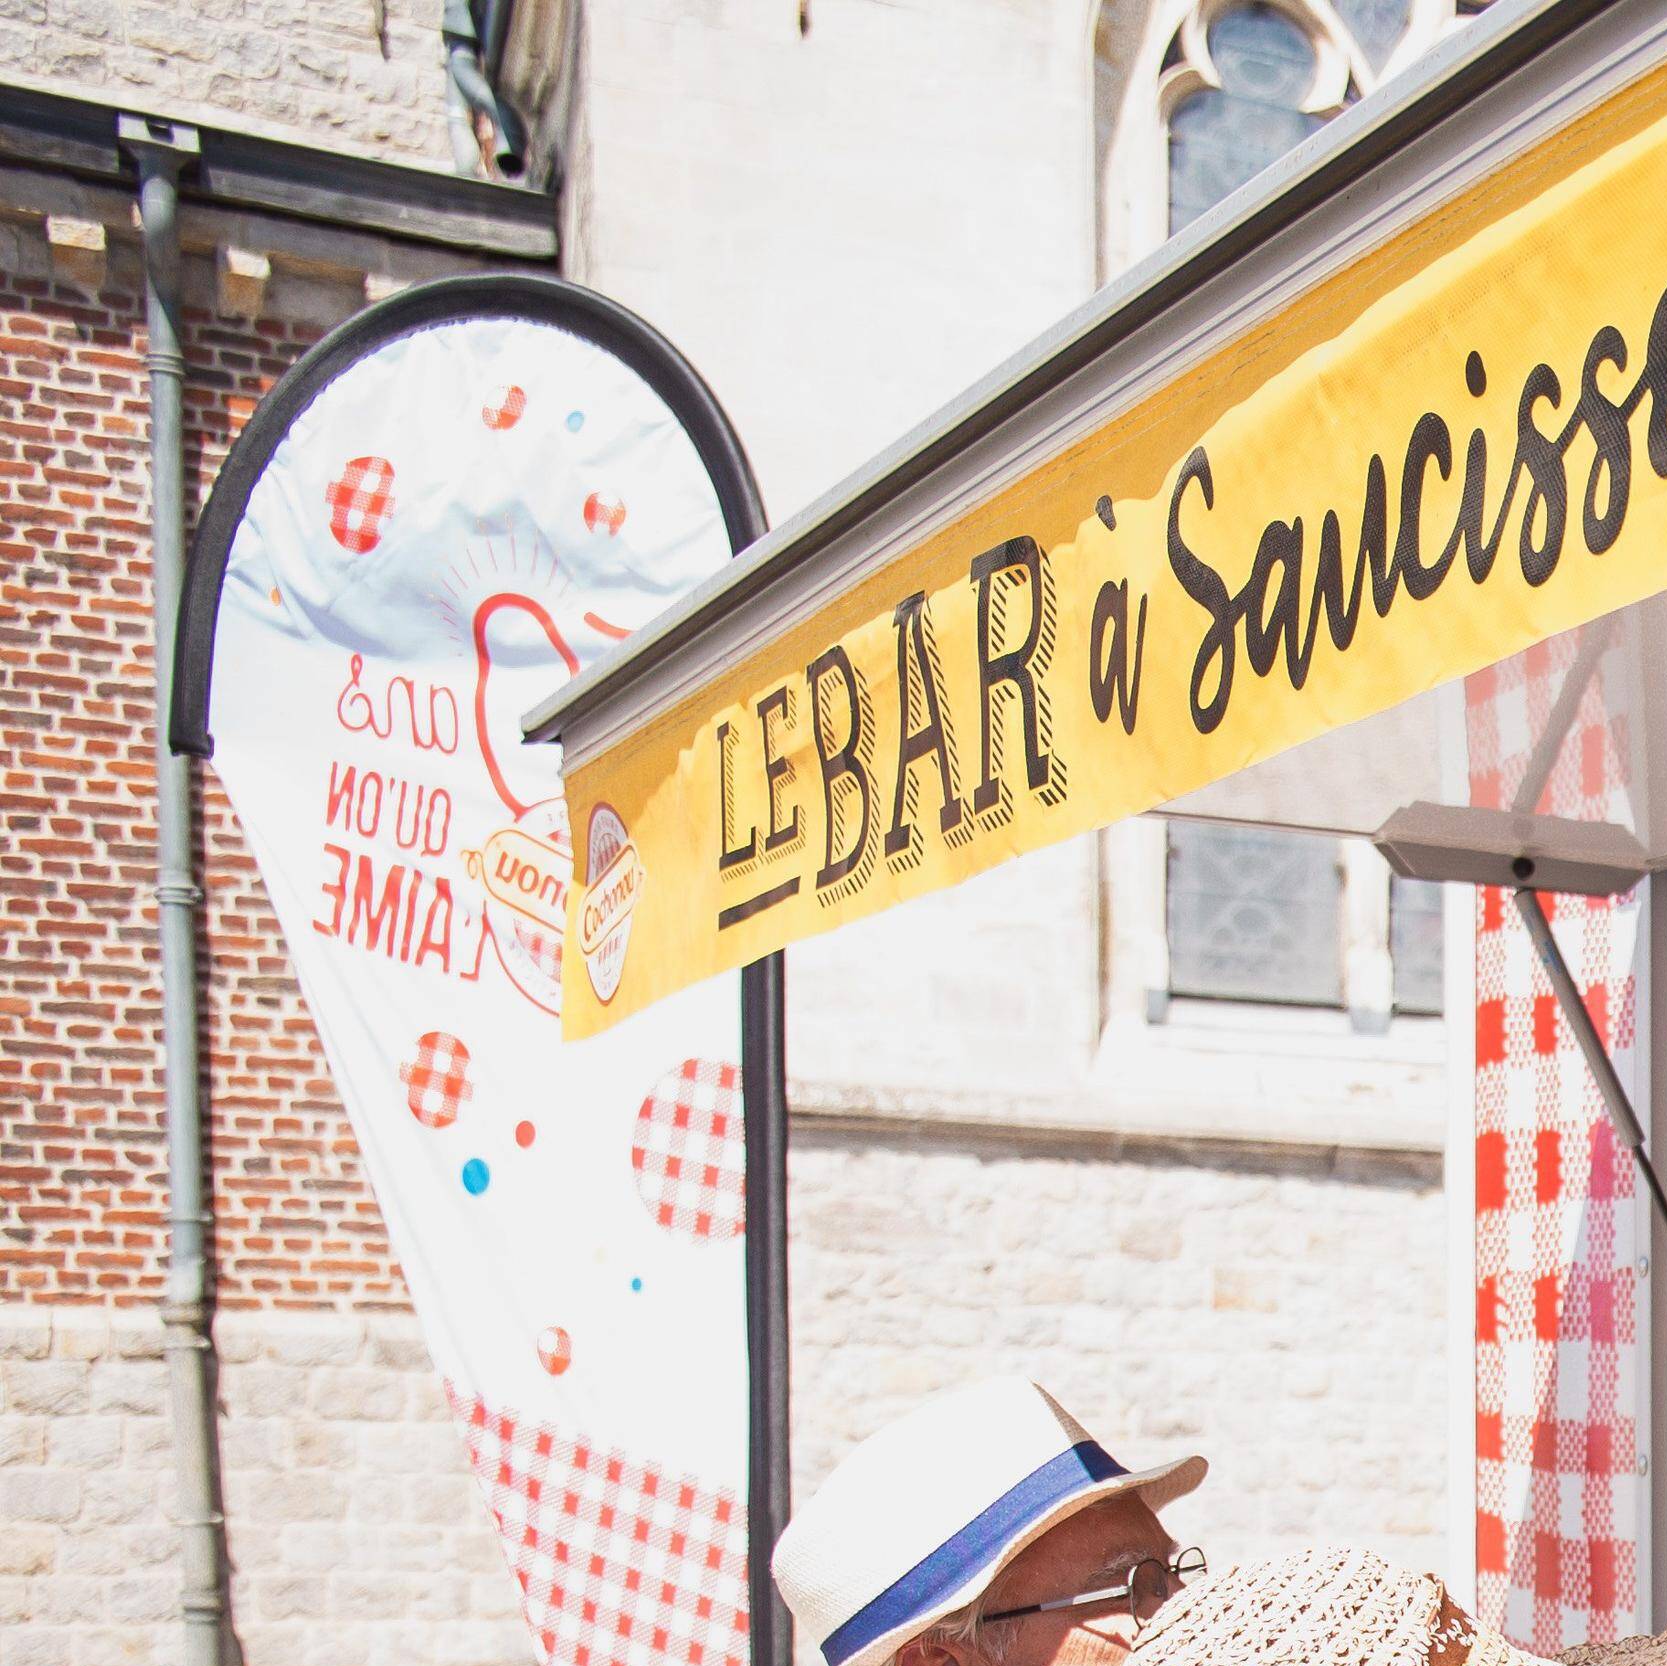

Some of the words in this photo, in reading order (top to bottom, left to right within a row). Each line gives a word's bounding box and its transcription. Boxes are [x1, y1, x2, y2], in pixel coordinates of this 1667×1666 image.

[716, 684, 807, 882] LE
[806, 535, 1068, 908] BAR
[1088, 494, 1148, 736] à
